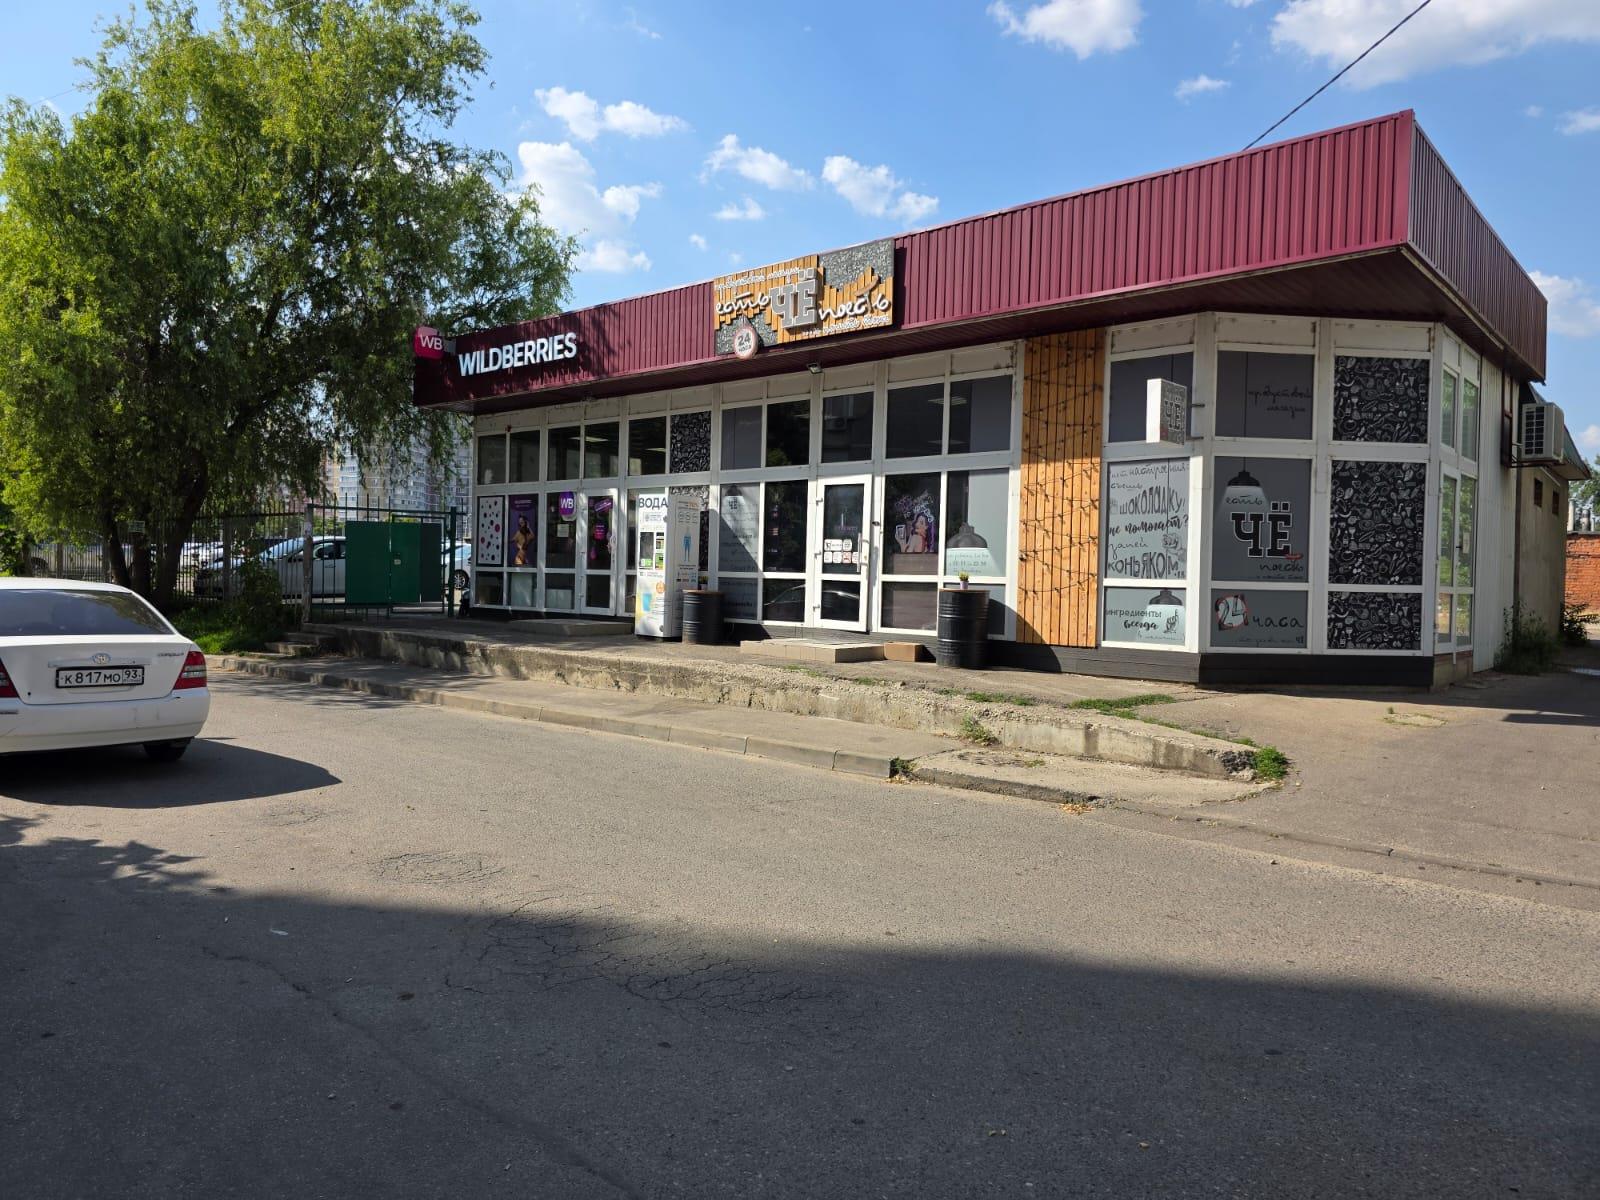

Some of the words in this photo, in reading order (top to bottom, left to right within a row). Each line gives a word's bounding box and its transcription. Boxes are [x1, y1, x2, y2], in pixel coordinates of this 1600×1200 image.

[769, 267, 819, 329] ЧЁ
[421, 335, 443, 350] WB
[738, 333, 750, 346] 24
[458, 332, 577, 377] WILDBERRIES
[561, 497, 574, 509] WB
[638, 497, 668, 510] ВОДА
[1230, 501, 1292, 558] ЧЁ
[1214, 593, 1249, 631] 24
[1252, 615, 1305, 628] часа
[124, 669, 138, 679] 93
